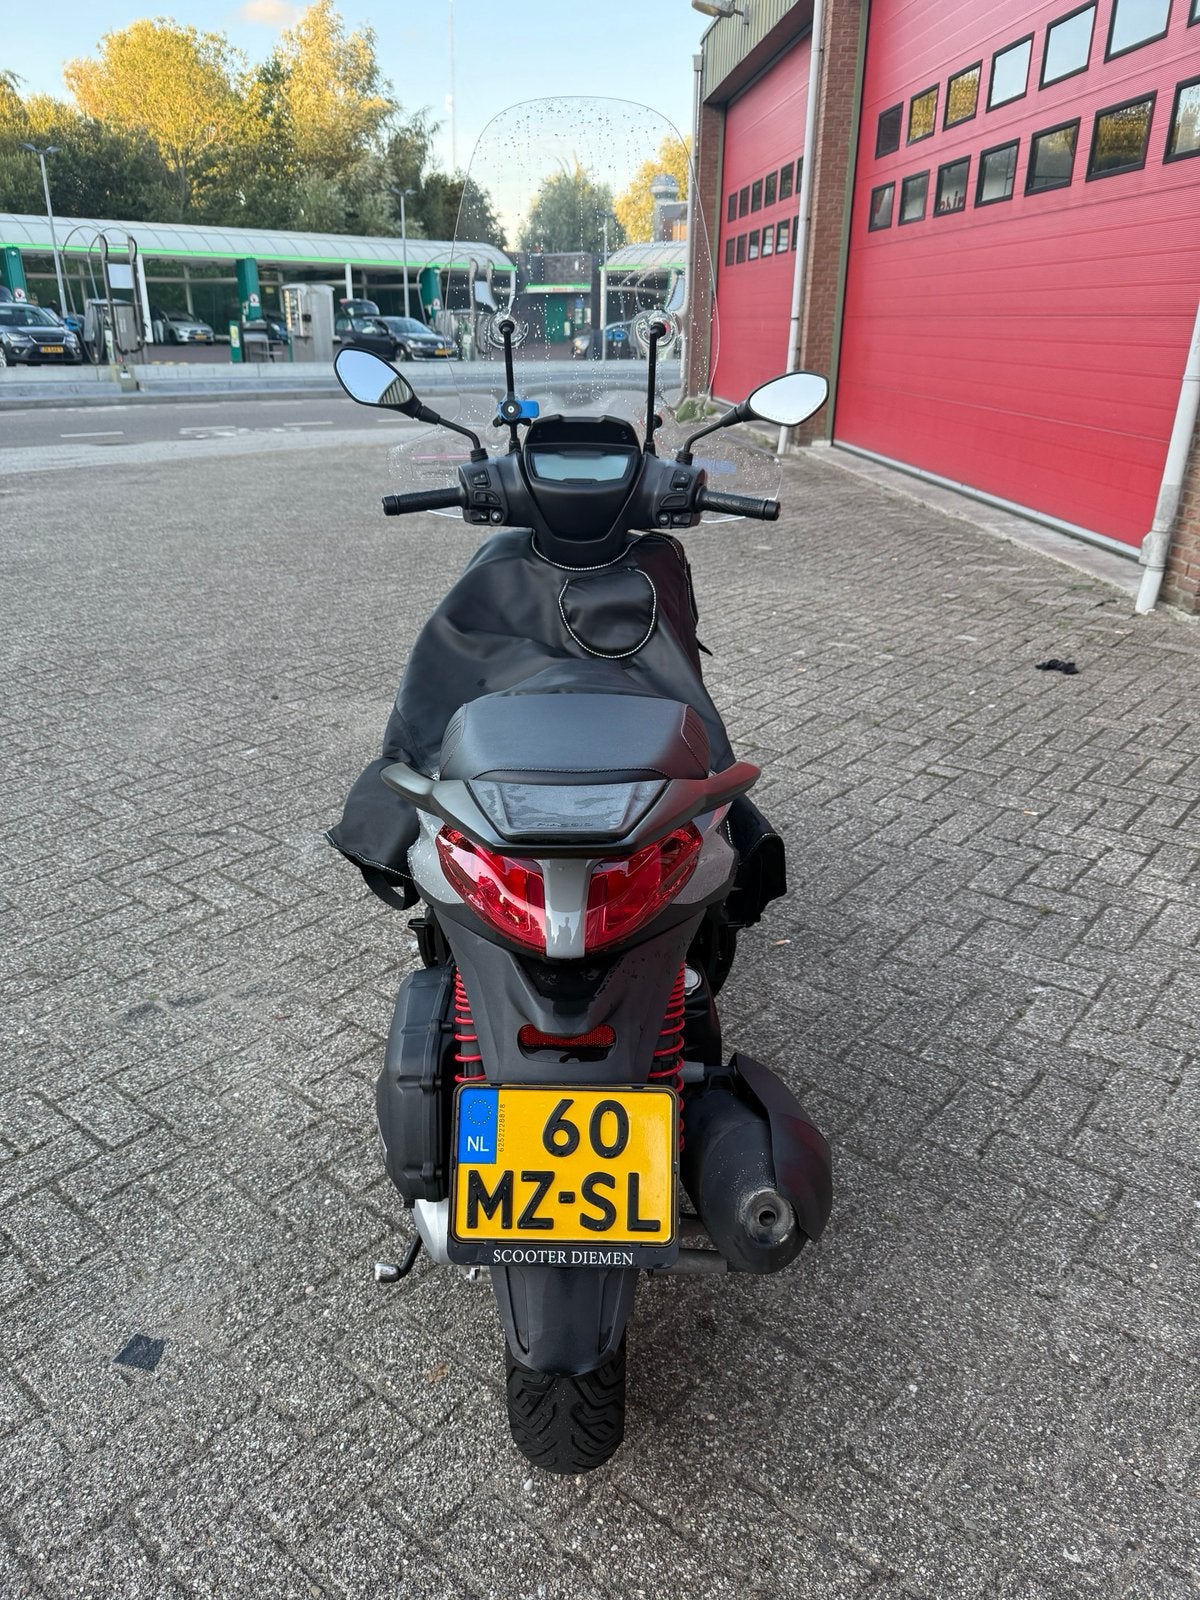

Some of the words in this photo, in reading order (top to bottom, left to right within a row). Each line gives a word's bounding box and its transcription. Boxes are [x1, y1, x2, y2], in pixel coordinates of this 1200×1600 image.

[467, 1135, 489, 1152] NL
[498, 1103, 506, 1152] 6252228878
[542, 1098, 630, 1159] 60
[466, 1170, 661, 1232] MZ-SL
[493, 1249, 567, 1264] SCOOTER
[570, 1250, 634, 1266] DIEMEN
